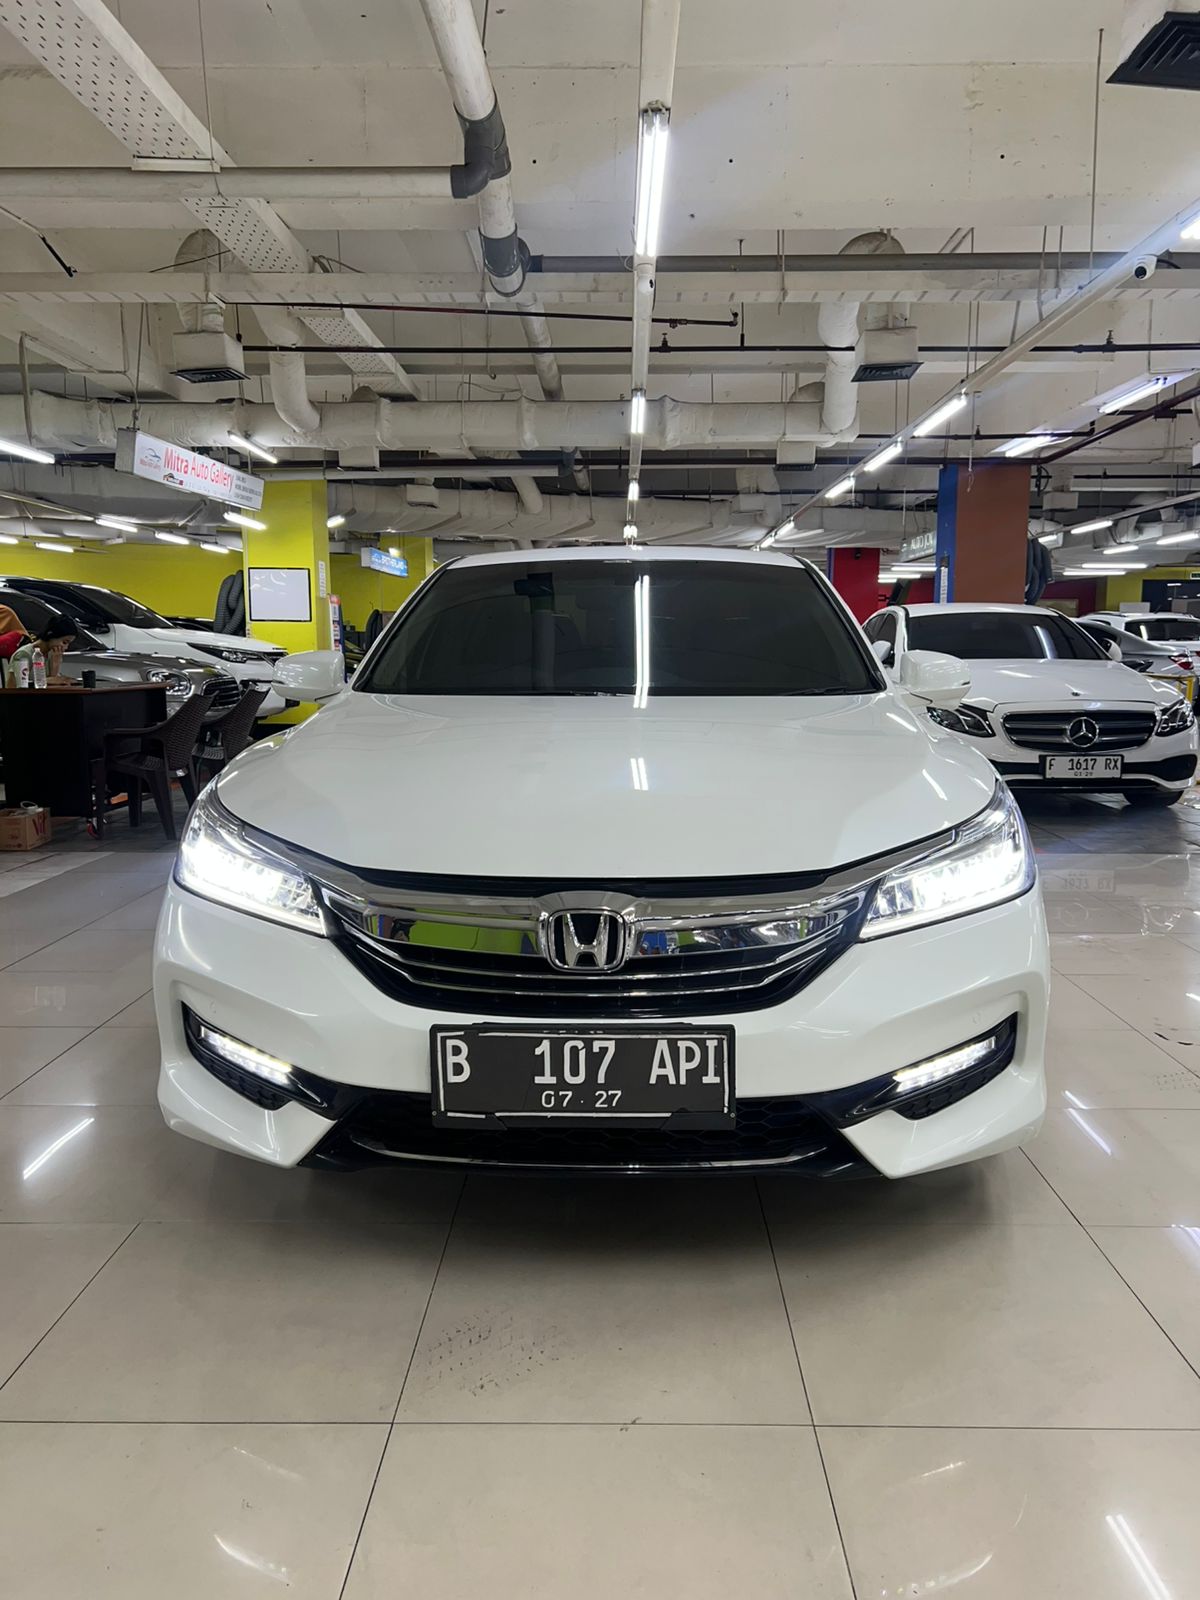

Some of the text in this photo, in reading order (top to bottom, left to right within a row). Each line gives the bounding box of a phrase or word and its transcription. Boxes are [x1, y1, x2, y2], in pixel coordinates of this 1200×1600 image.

[164, 447, 189, 475] Mitra
[191, 456, 209, 480] Auto
[210, 462, 234, 493] Gallery
[1048, 758, 1119, 771] F 1617 RX
[445, 1039, 721, 1085] B 107 API
